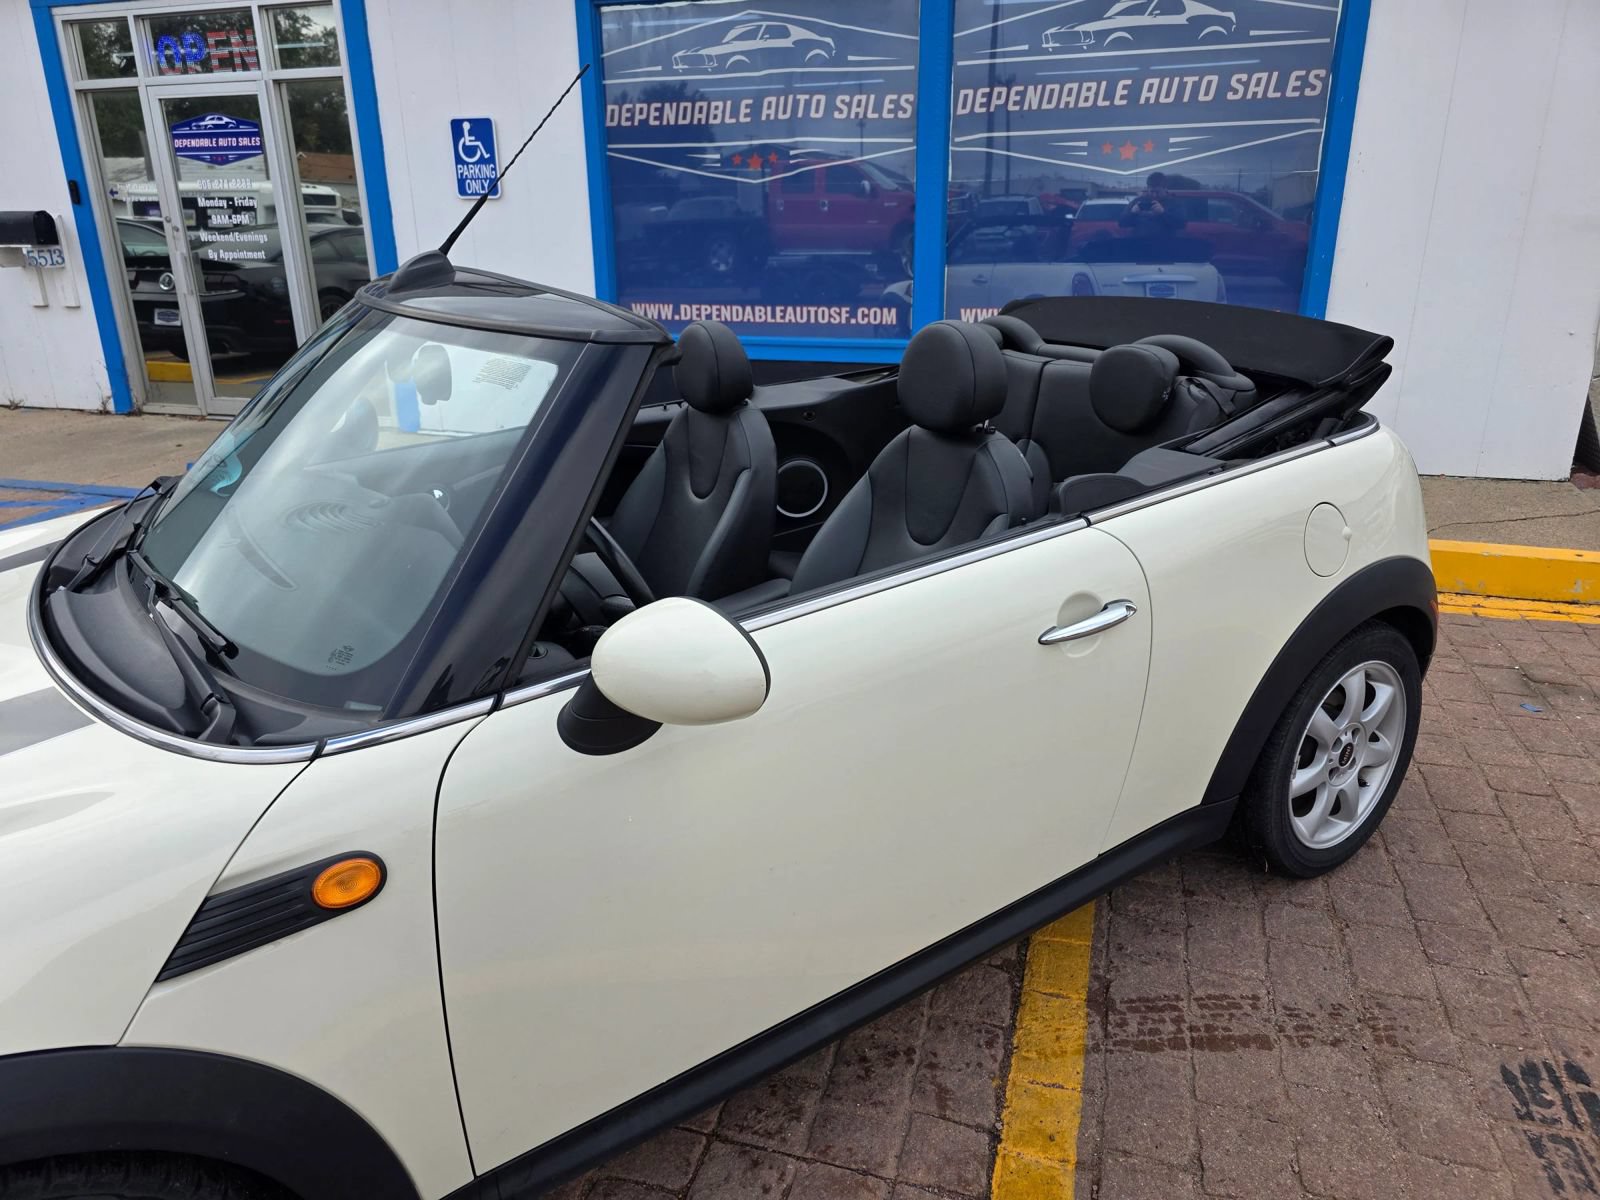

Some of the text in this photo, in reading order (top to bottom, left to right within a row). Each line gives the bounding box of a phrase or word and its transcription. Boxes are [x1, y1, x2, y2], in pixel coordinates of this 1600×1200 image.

[157, 29, 259, 74] OPEN
[956, 69, 1328, 115] DEPENDABLE AUTO SALES
[605, 93, 915, 127] DEPENDABLE AUTO SALES
[174, 136, 261, 148] DEPENDABLE AUTO SALES
[457, 164, 496, 179] PARKING
[465, 179, 490, 194] ONLY
[197, 197, 228, 209] Monday
[234, 196, 258, 209] Friday
[211, 214, 250, 225] 9AM-6PM
[200, 231, 268, 244] Weekend/Evenings
[27, 249, 65, 266] 5513
[208, 249, 266, 260] By Appointment
[631, 303, 897, 325] WWW.DEPENDABLEAUTOSF.COM
